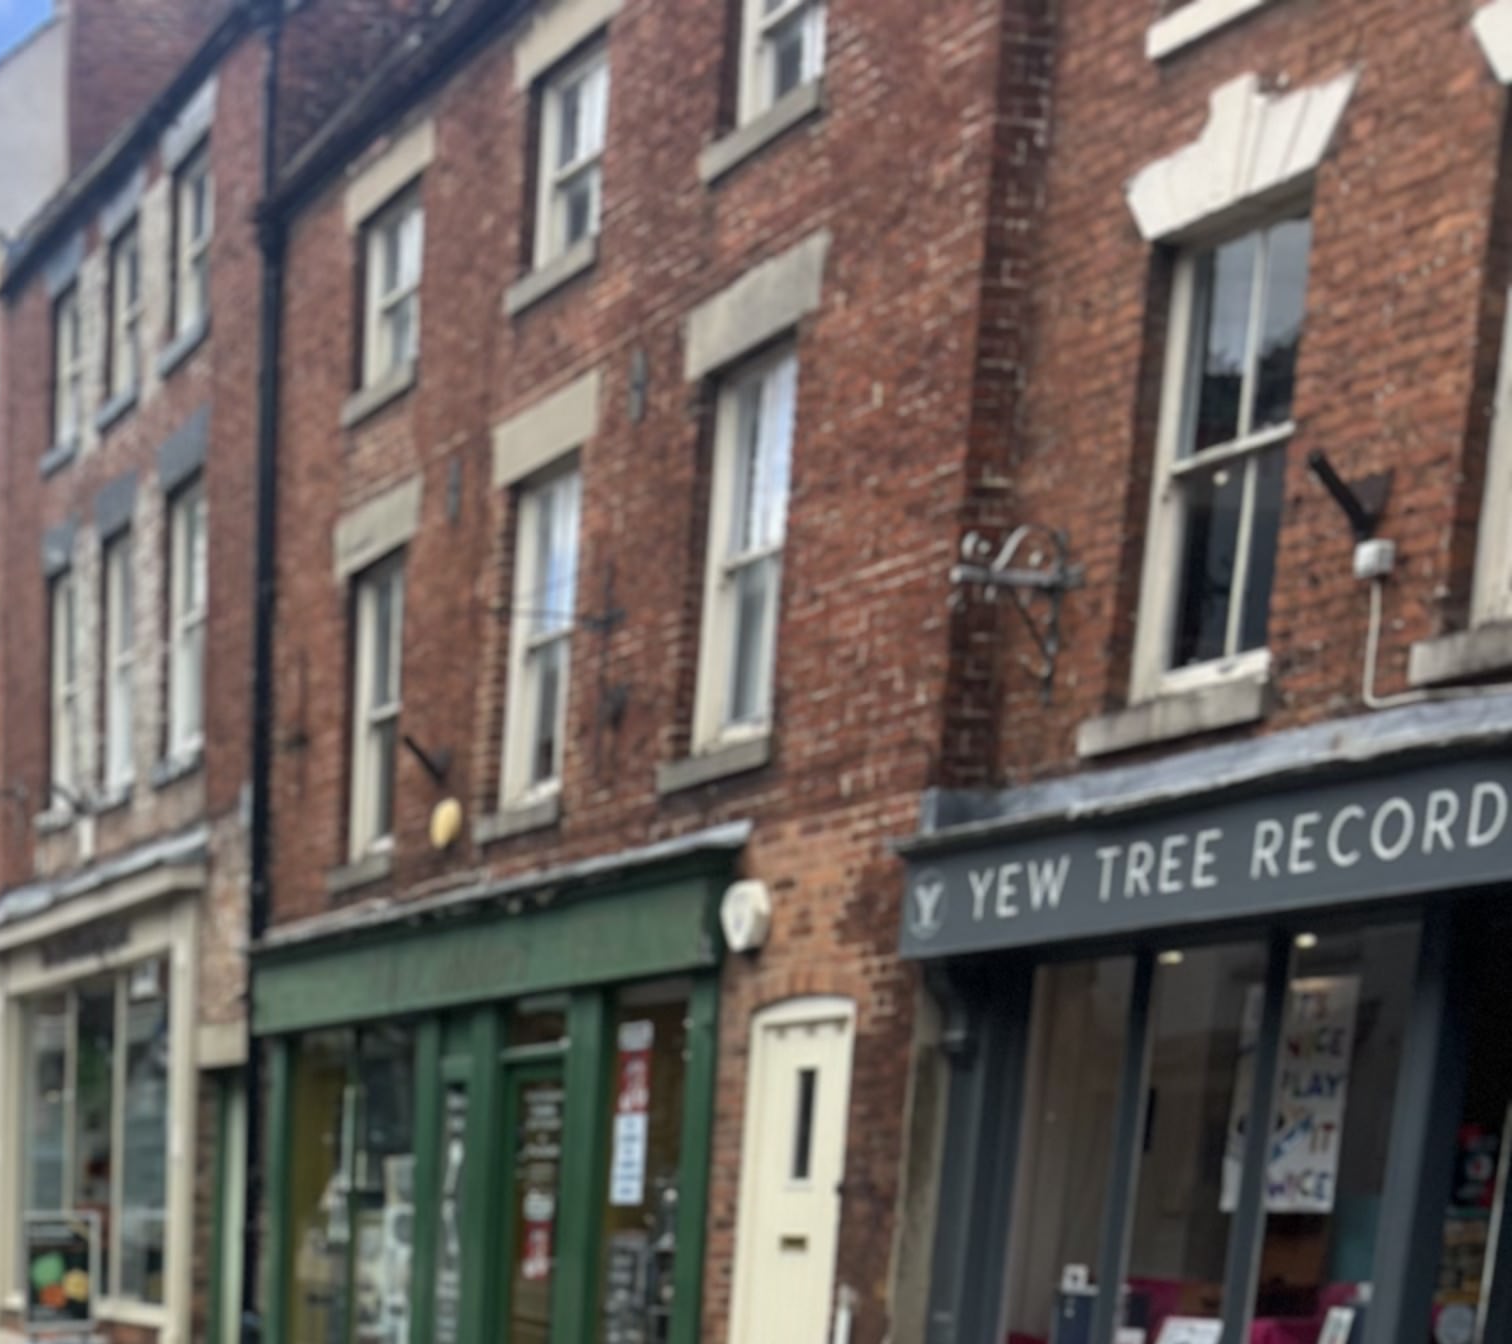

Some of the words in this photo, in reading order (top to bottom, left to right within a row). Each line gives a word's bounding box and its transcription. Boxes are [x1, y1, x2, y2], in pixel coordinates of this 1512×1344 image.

[967, 855, 1071, 921] YEW
[1095, 828, 1223, 902] TREE
[1249, 781, 1510, 880] RECORD
